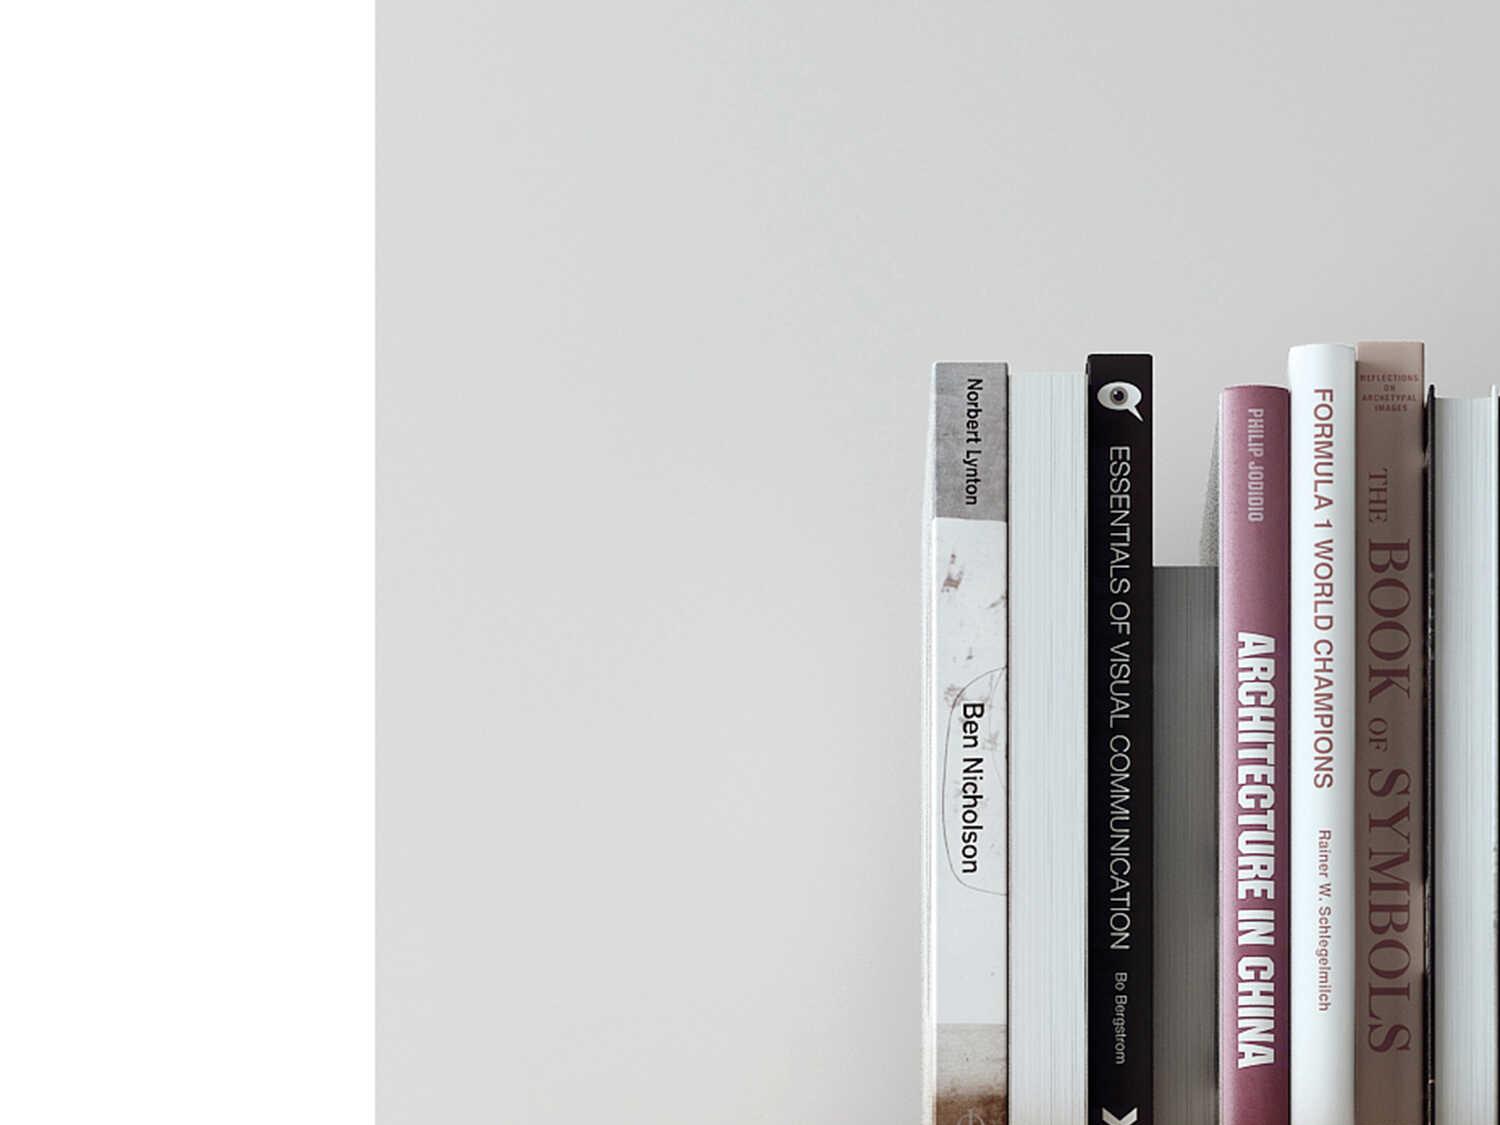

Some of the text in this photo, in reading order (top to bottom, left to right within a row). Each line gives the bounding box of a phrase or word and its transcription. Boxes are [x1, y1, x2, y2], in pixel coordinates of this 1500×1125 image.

[963, 379, 983, 504] Norbert Lynton
[1248, 408, 1265, 522] PHILIP JODIDIO
[1383, 383, 1396, 392] ON
[1314, 389, 1333, 788] FORMULA 1 WORLD CHAMPIONS
[1110, 446, 1130, 949] ESSENTIALS OF VISUAL COMMUNICATION
[1368, 469, 1412, 1052] THE BOOK OF SYMBOLS
[962, 703, 984, 873] Ben Nicholson
[1237, 631, 1276, 1069] ARCHITECTURE IN CHINA
[1316, 830, 1332, 1011] Rainer W. Schlegelmilch
[1113, 973, 1127, 1064] Bo Bergstrom
